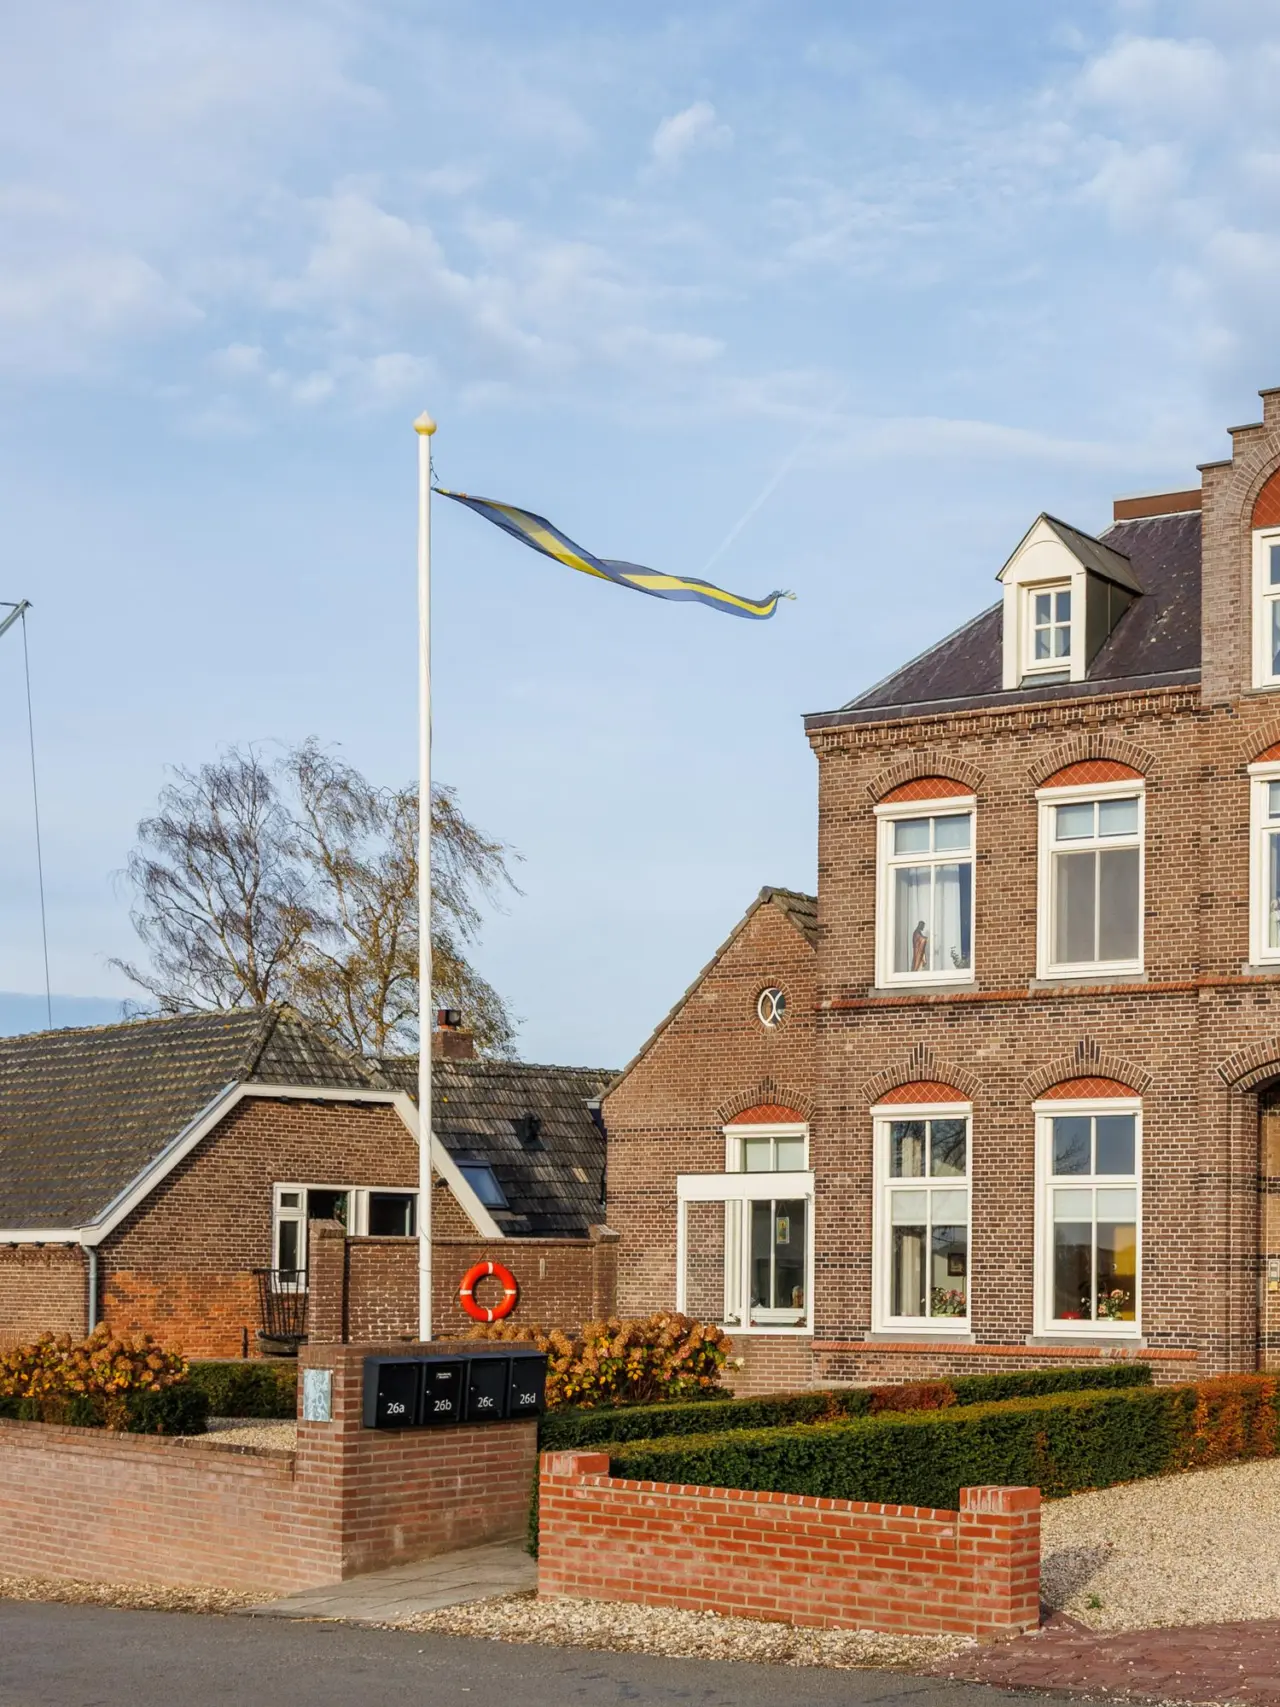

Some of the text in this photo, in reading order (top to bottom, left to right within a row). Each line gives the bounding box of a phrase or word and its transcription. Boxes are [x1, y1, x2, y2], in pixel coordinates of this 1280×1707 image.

[477, 1396, 494, 1408] 26c
[520, 1393, 536, 1404] 26d
[387, 1403, 405, 1414] 26a
[434, 1399, 452, 1411] 26b
